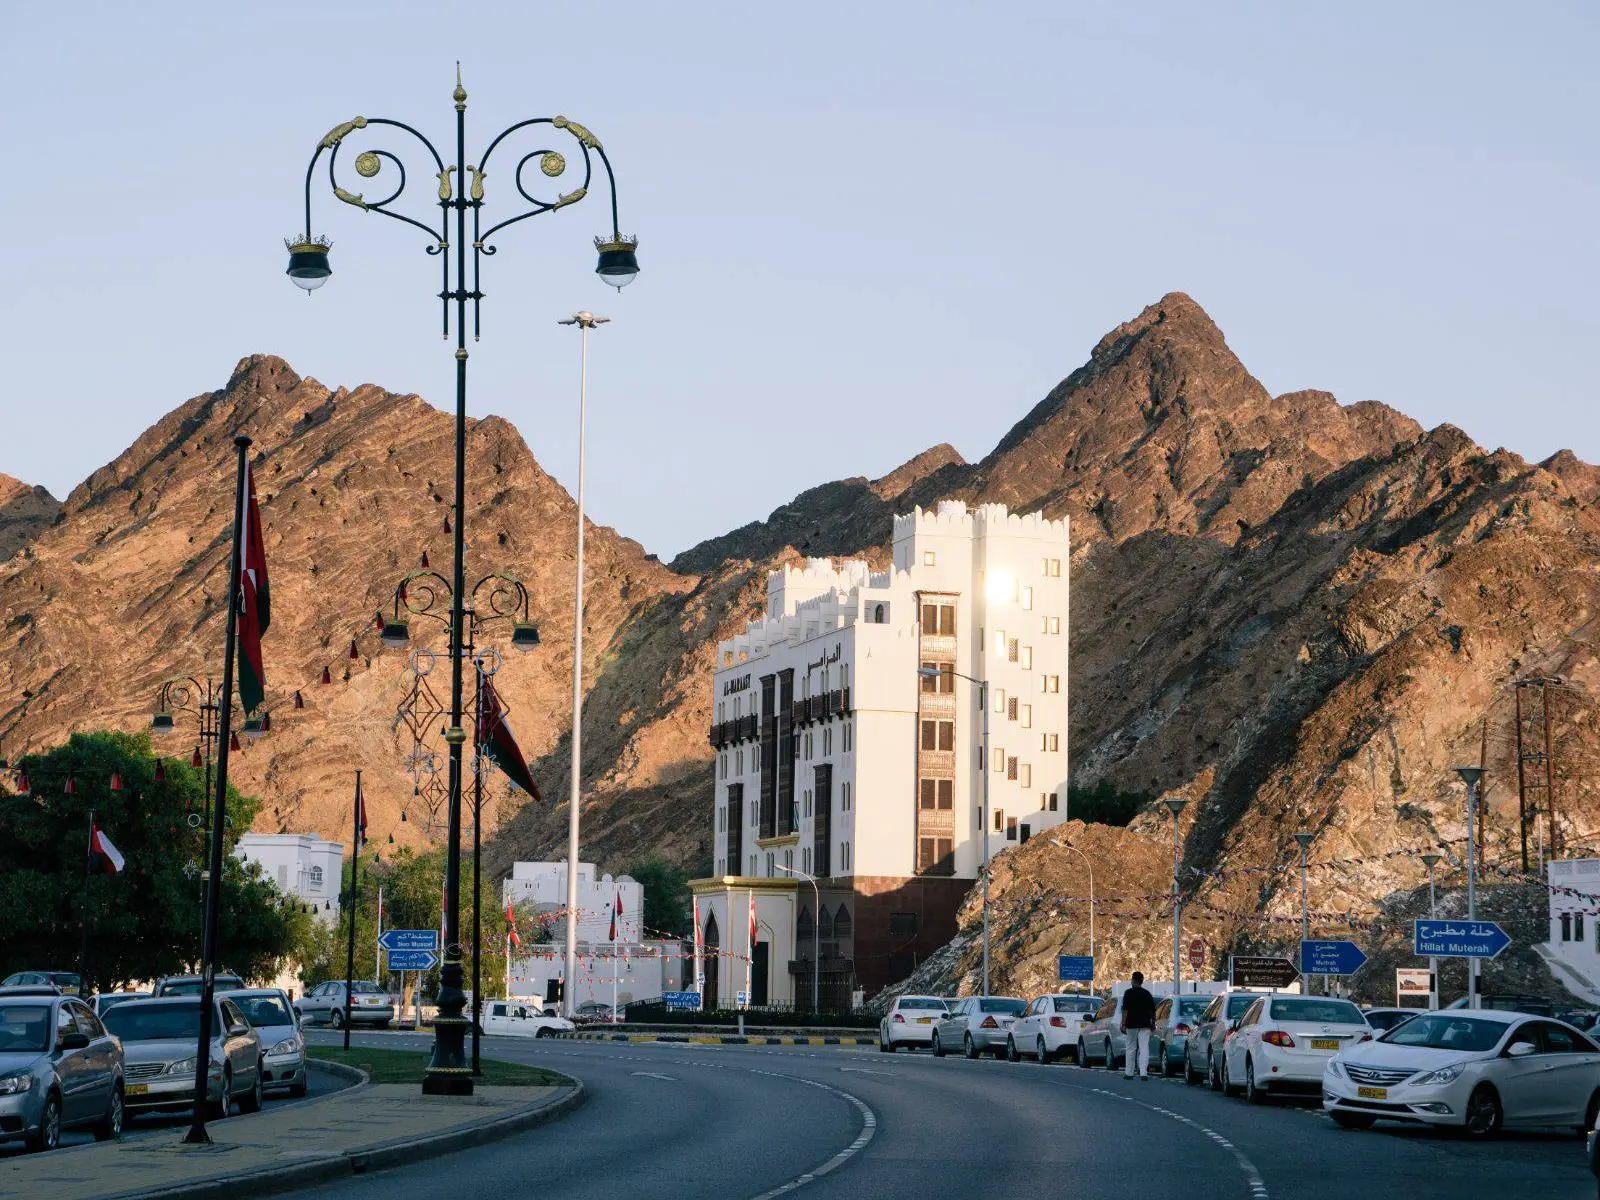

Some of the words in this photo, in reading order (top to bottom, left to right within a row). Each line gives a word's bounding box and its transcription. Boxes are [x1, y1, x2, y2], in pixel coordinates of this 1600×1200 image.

[1420, 924, 1466, 939] مطيرح
[1470, 925, 1495, 936] حلة
[1420, 943, 1444, 951] Hillat
[1449, 943, 1489, 953] Muterah
